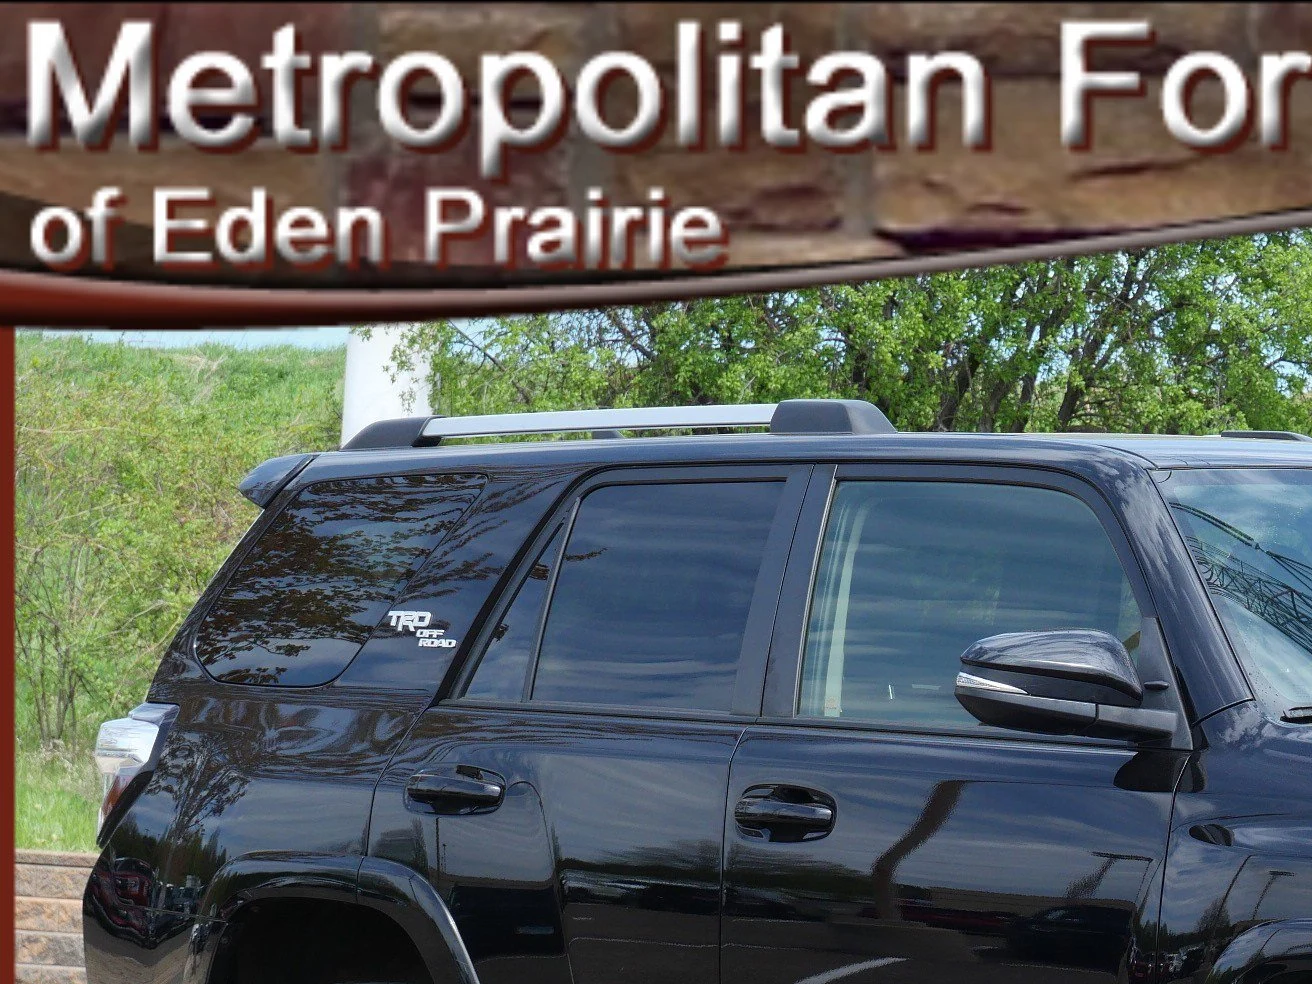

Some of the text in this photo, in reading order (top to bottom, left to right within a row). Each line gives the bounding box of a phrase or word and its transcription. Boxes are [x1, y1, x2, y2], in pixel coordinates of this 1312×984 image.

[387, 610, 432, 632] TRD
[416, 629, 445, 638] OFF
[418, 638, 457, 648] ROAD
